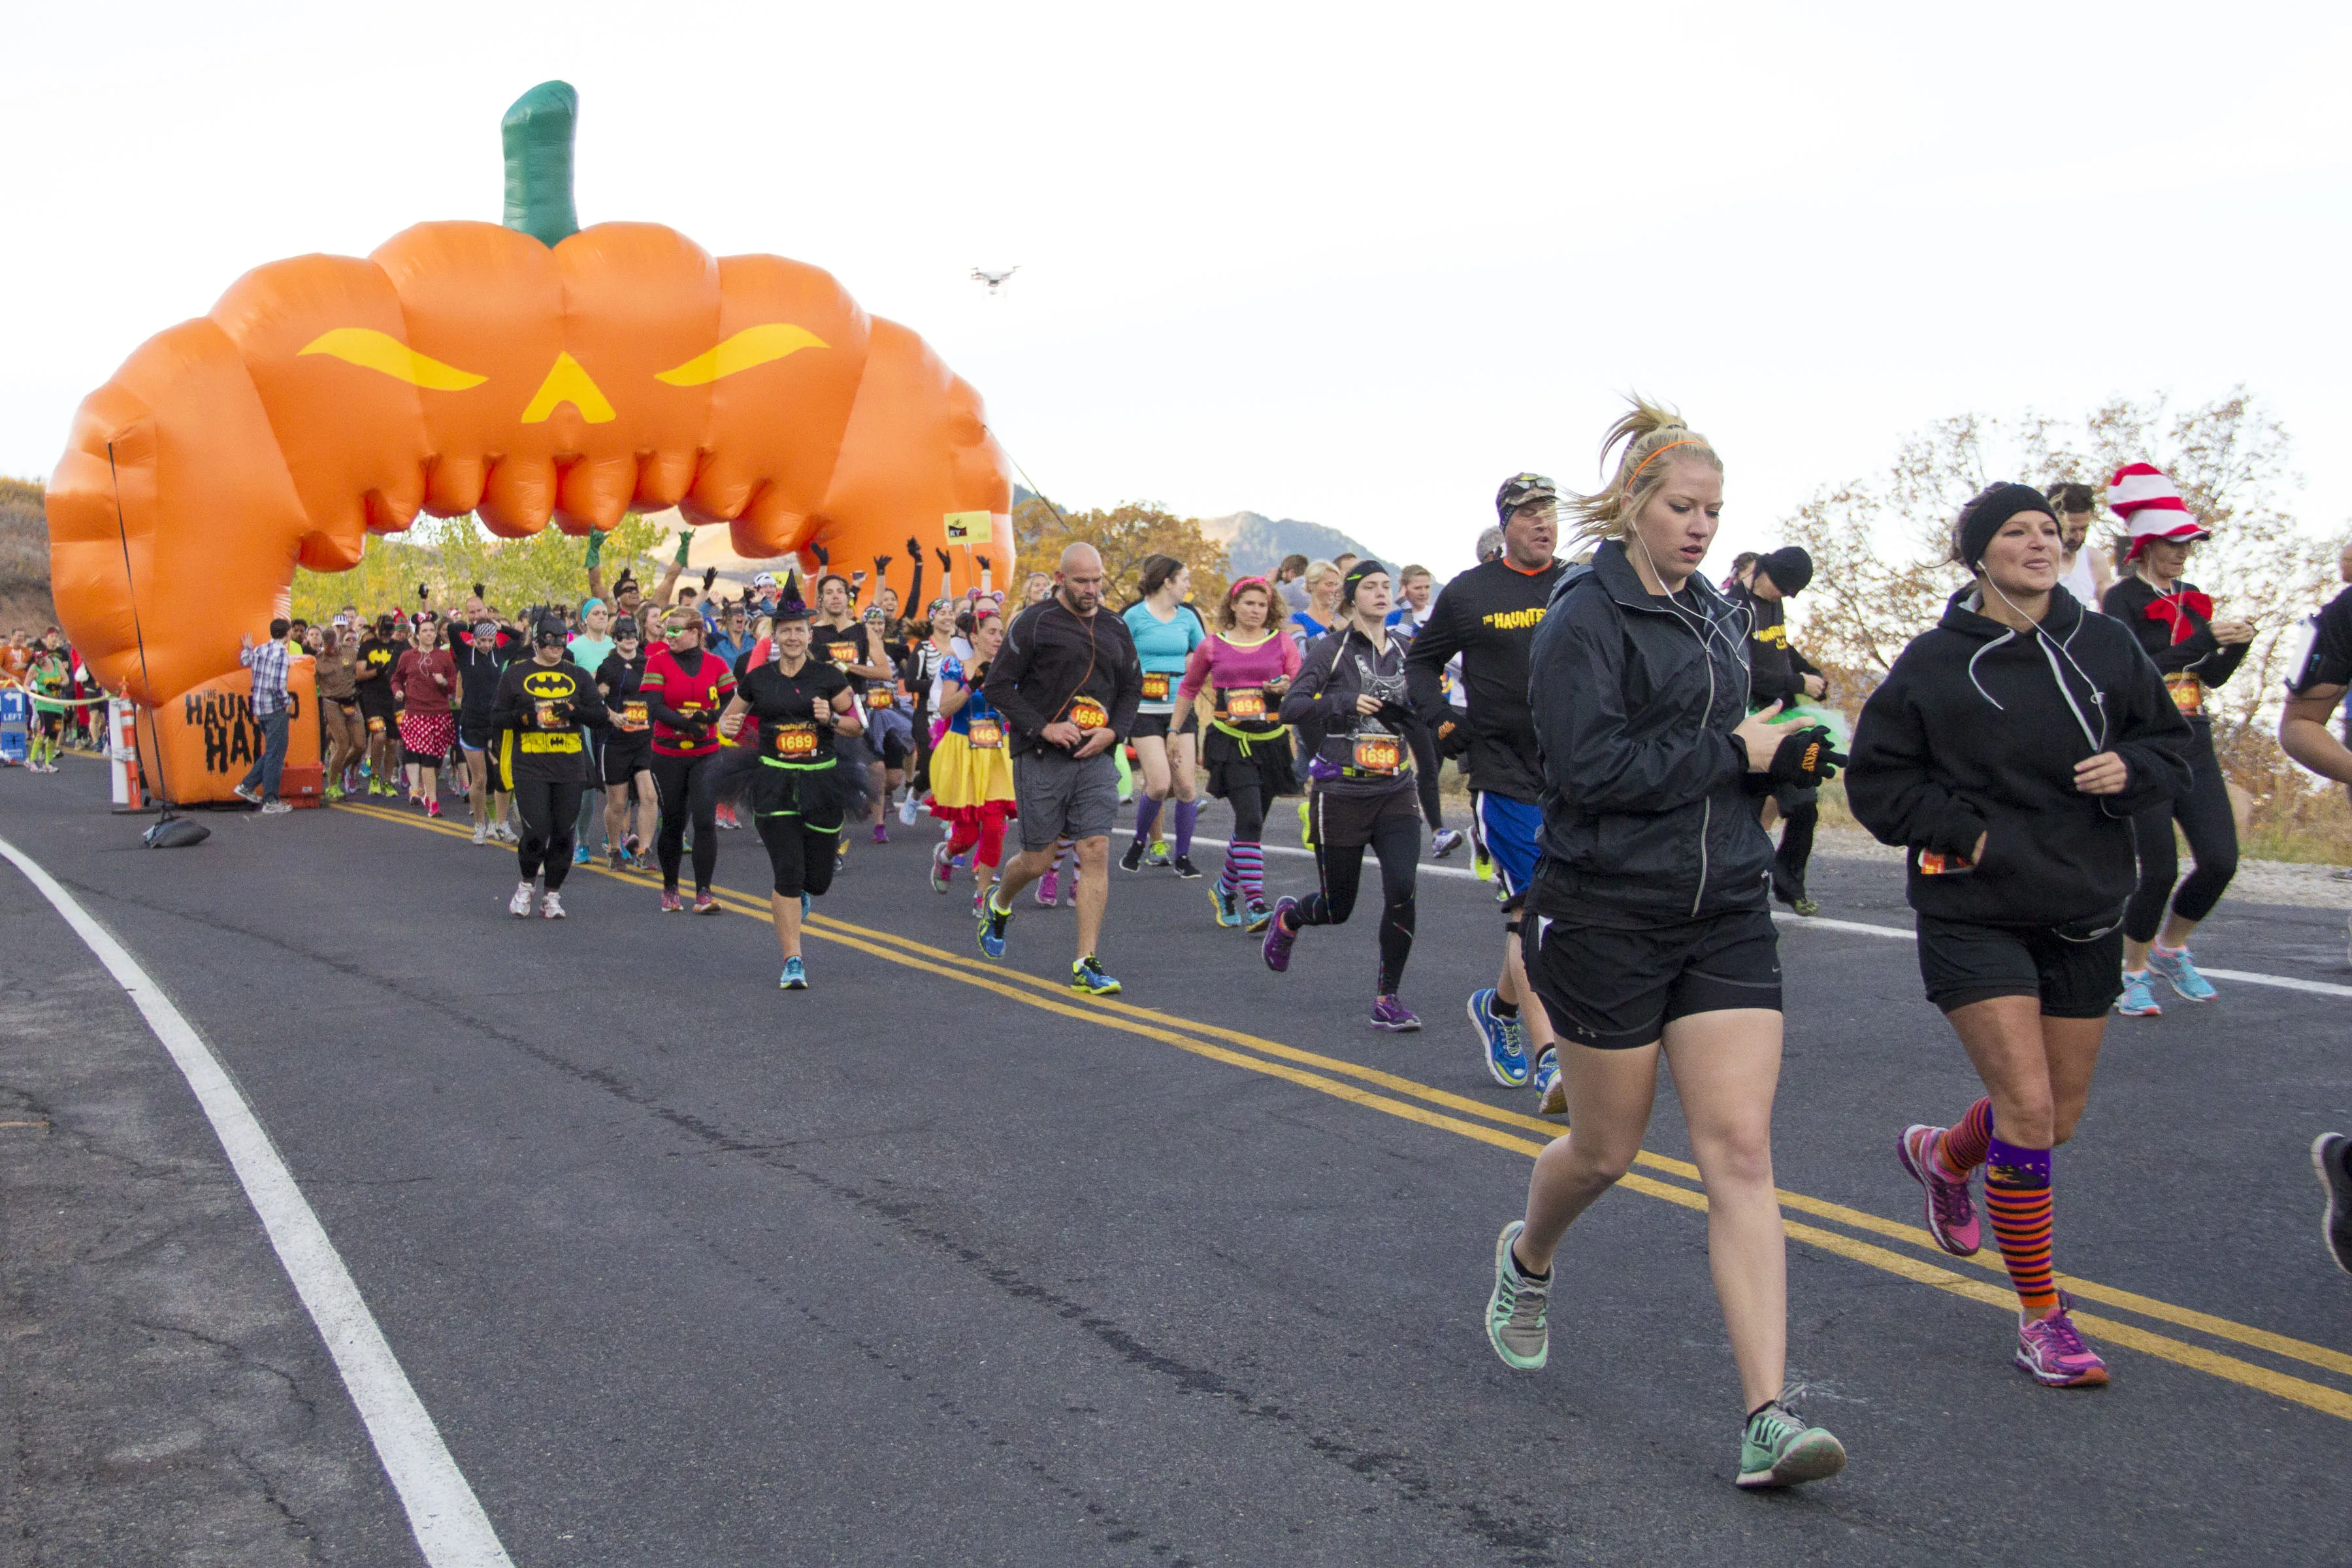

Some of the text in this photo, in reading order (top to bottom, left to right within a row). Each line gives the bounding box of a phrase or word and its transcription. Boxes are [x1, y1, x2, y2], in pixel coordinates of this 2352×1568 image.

[1494, 608, 1547, 630] HAUNTE
[203, 689, 217, 701] THE
[709, 685, 718, 700] R
[1232, 700, 1262, 713] 1894
[3, 713, 23, 721] LEFT
[627, 708, 647, 721] 4242
[1076, 709, 1104, 727] 1685
[973, 728, 998, 741] 1463
[781, 734, 813, 751] 1689
[1361, 747, 1396, 764] 1698
